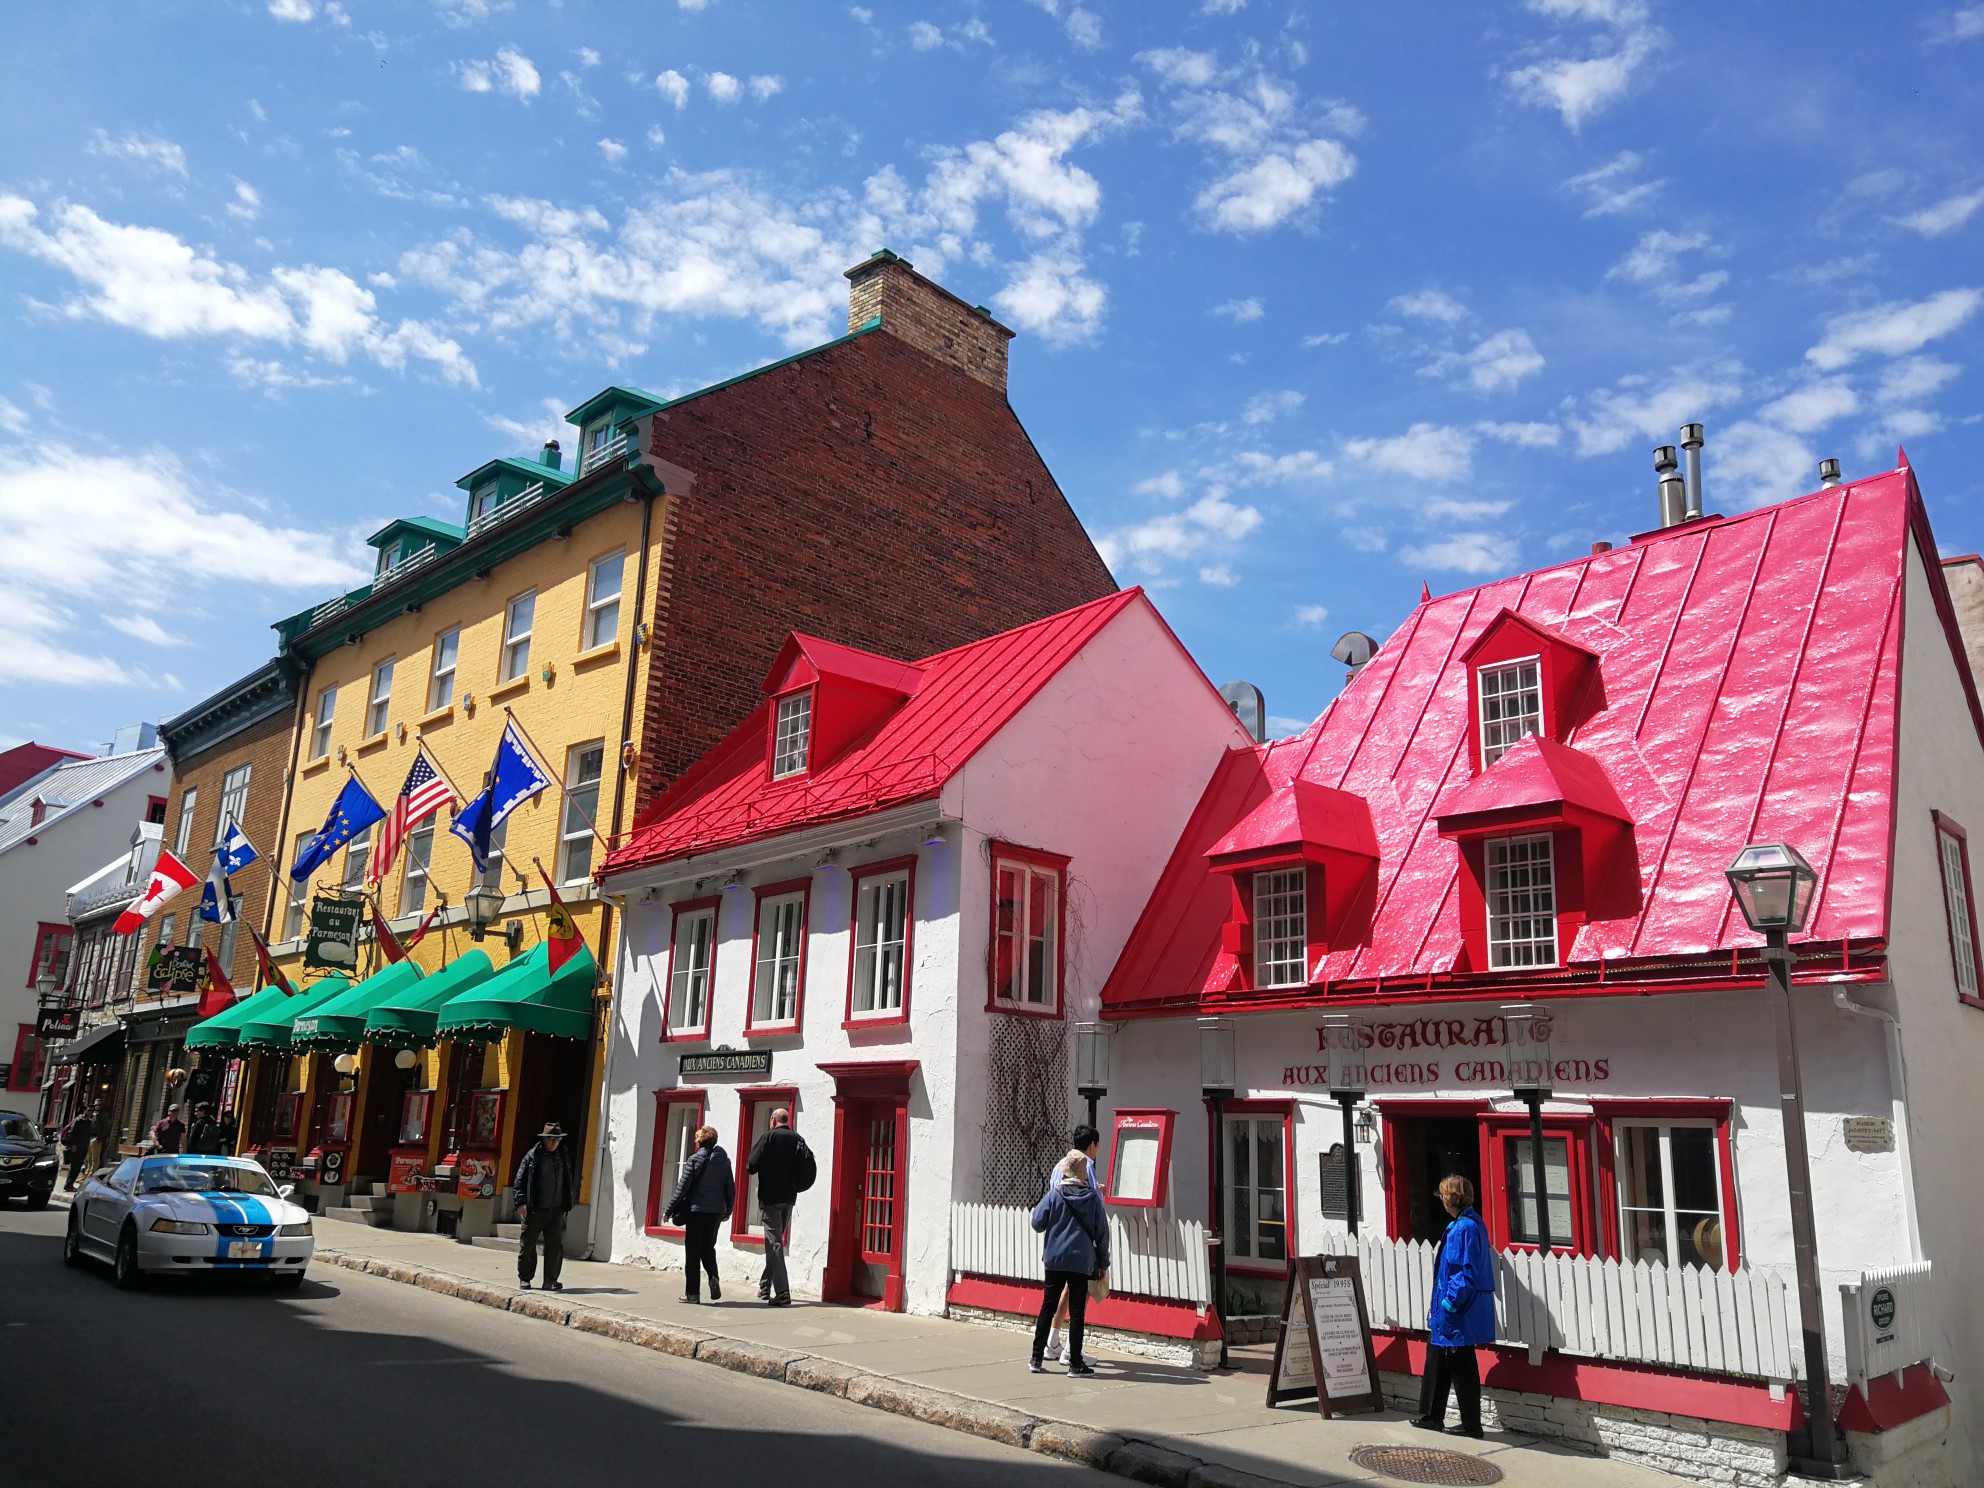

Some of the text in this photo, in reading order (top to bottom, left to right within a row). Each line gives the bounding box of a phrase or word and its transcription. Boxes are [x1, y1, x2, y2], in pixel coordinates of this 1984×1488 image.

[315, 901, 360, 917] Restaurant
[328, 918, 340, 926] au
[311, 926, 352, 942] Parmesan
[153, 960, 194, 985] Eclipse
[683, 1055, 766, 1071] AUX ANCIENS CANADIENS
[1282, 1064, 1327, 1087] AUX
